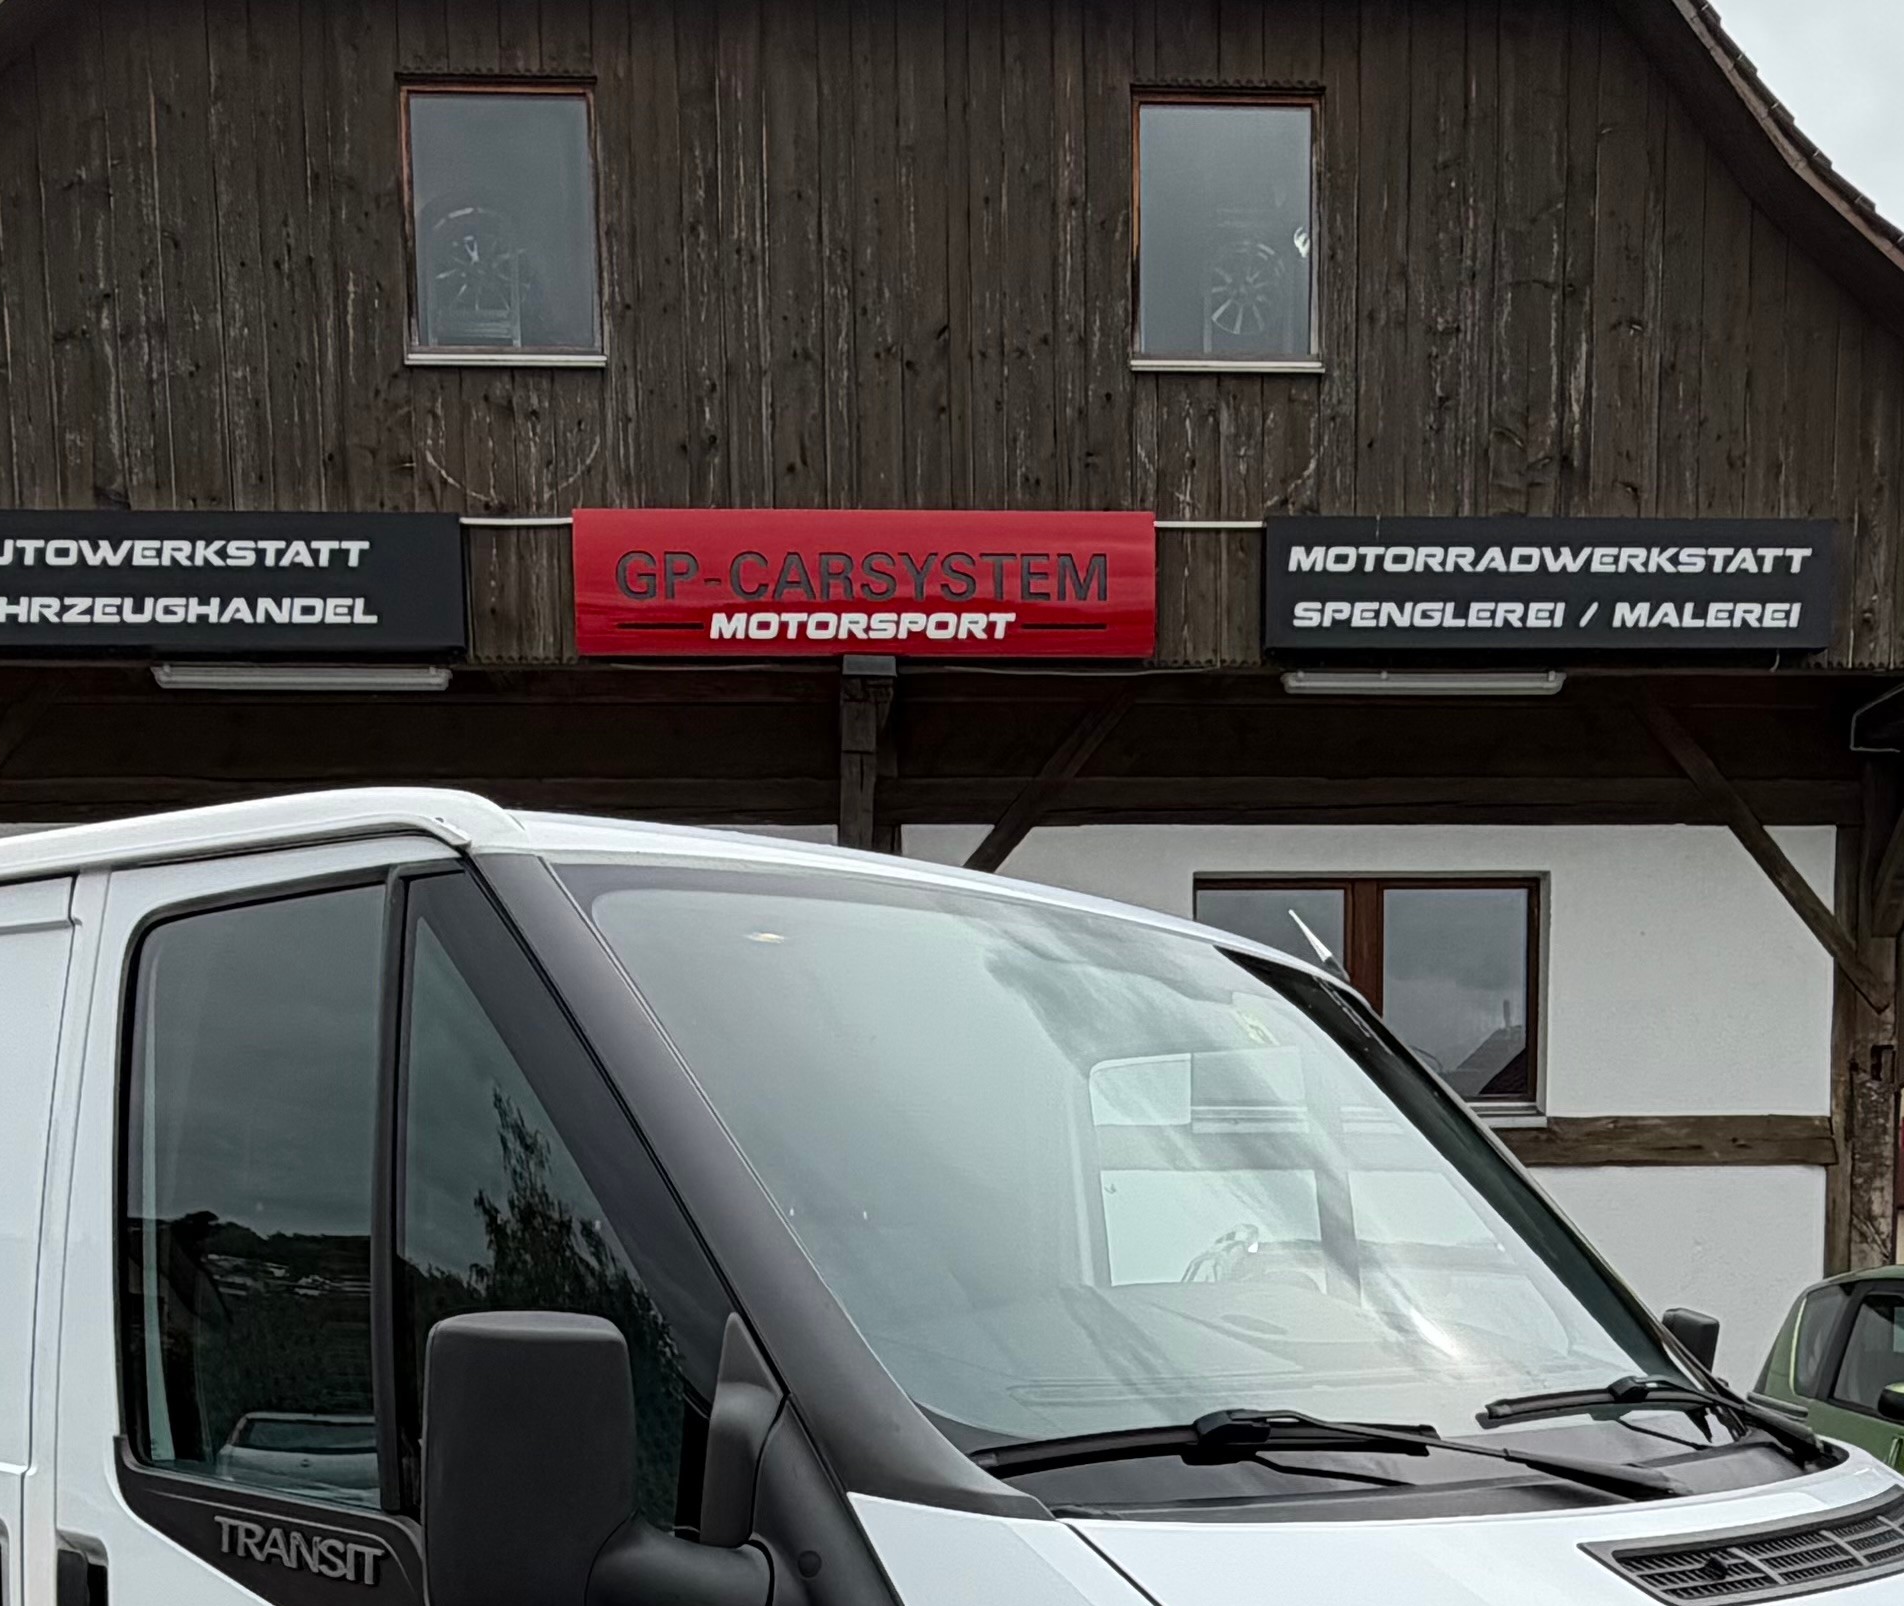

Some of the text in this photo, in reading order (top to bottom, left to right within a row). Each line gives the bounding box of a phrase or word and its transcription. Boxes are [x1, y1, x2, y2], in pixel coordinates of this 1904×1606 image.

[1287, 545, 1813, 574] MOTORRADWERKSTATT
[614, 549, 1109, 603] GP-CARSYSTEM
[709, 612, 1017, 640] MOTORSPORT
[1292, 601, 1802, 629] SPENGLEREI / MALEREI
[214, 1515, 385, 1585] TRANSIT
